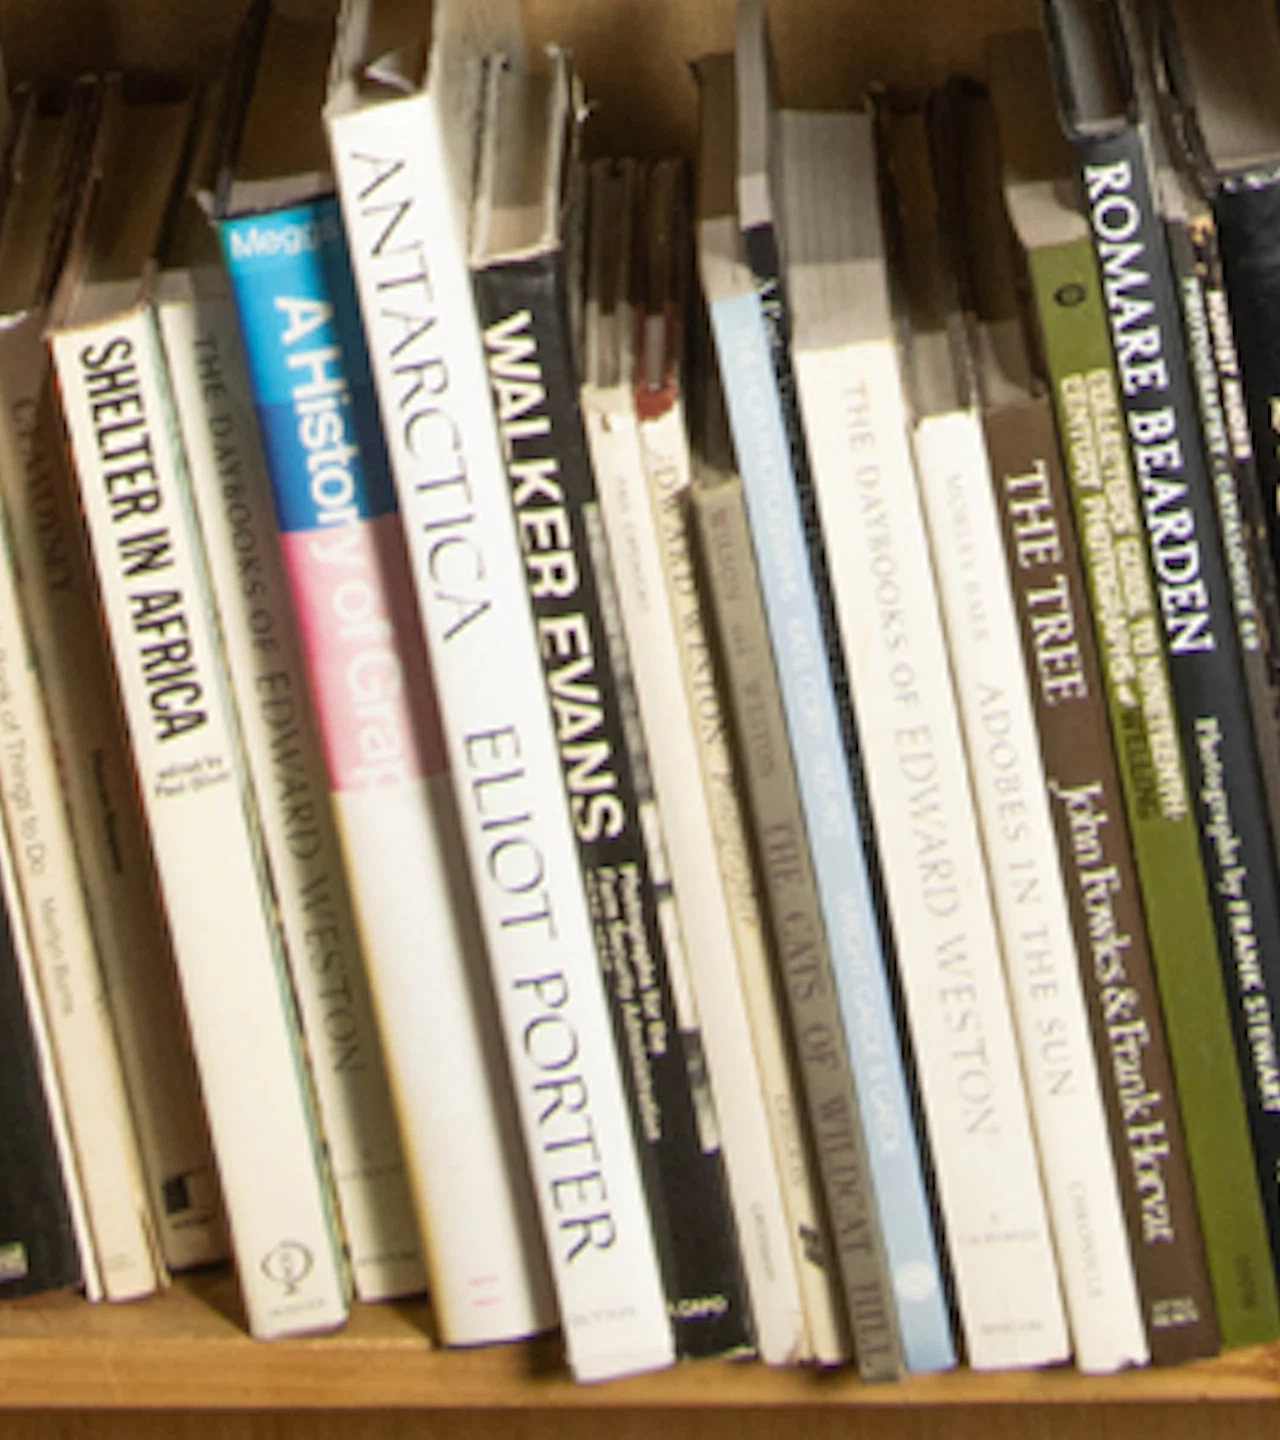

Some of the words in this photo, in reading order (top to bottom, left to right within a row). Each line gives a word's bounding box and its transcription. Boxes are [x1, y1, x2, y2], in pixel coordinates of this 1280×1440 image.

[78, 335, 176, 525] SHELTER
[346, 147, 491, 643] ANTARCTICA
[1083, 161, 1156, 397] ROMARE
[1126, 410, 1213, 656] BEARDEN
[111, 531, 185, 578] IN
[479, 308, 577, 600] WALKER
[534, 611, 624, 843] EVANS
[1002, 461, 1054, 576] THE
[127, 591, 209, 743] AFRICA
[1017, 588, 1086, 705] TREE
[460, 719, 560, 950] ELIOT
[1048, 779, 1112, 859] John
[1083, 866, 1135, 978] Fowles
[1104, 984, 1141, 1013] &
[508, 970, 618, 1267] PORTER
[1106, 1017, 1160, 1117] Frank
[1118, 1123, 1179, 1242] Horvat
